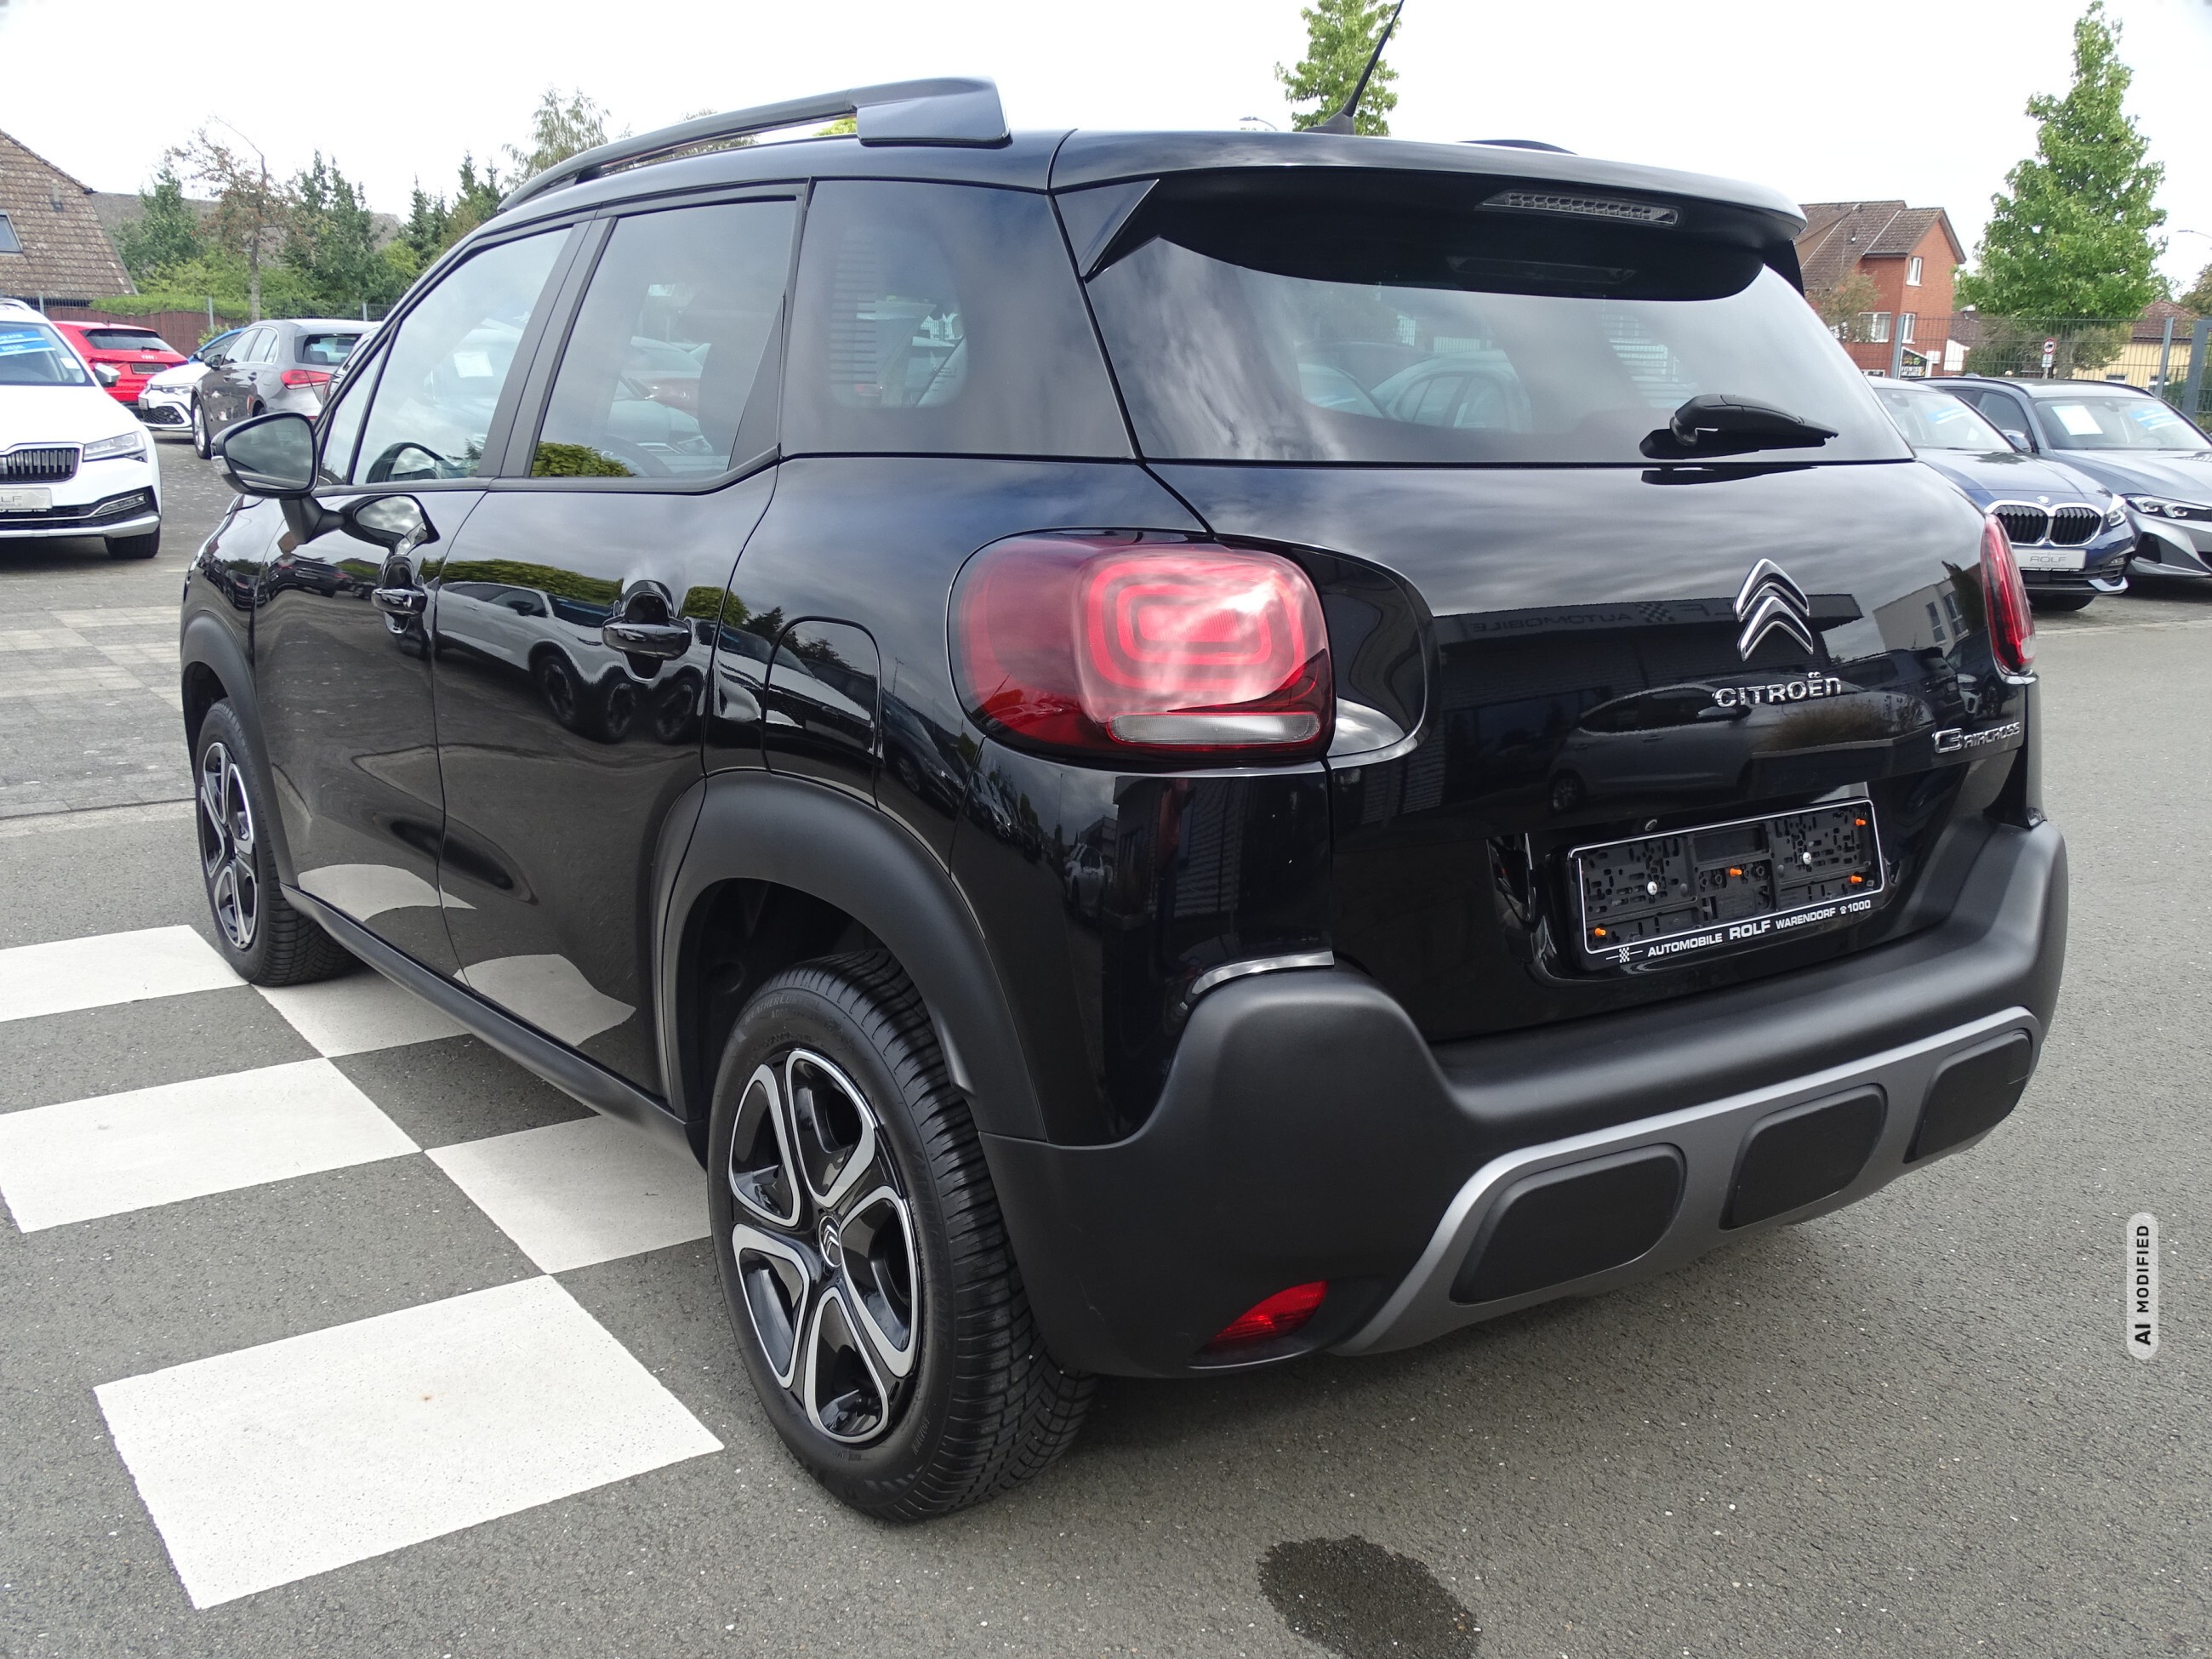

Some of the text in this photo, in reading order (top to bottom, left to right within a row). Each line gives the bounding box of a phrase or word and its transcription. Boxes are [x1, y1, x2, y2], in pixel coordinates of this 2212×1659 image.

[1711, 671, 1842, 708] CITROËN
[1963, 721, 2021, 749] AIRCROSS
[1647, 899, 1872, 958] AUTOMOBILE ROLF WARENDORF 1000
